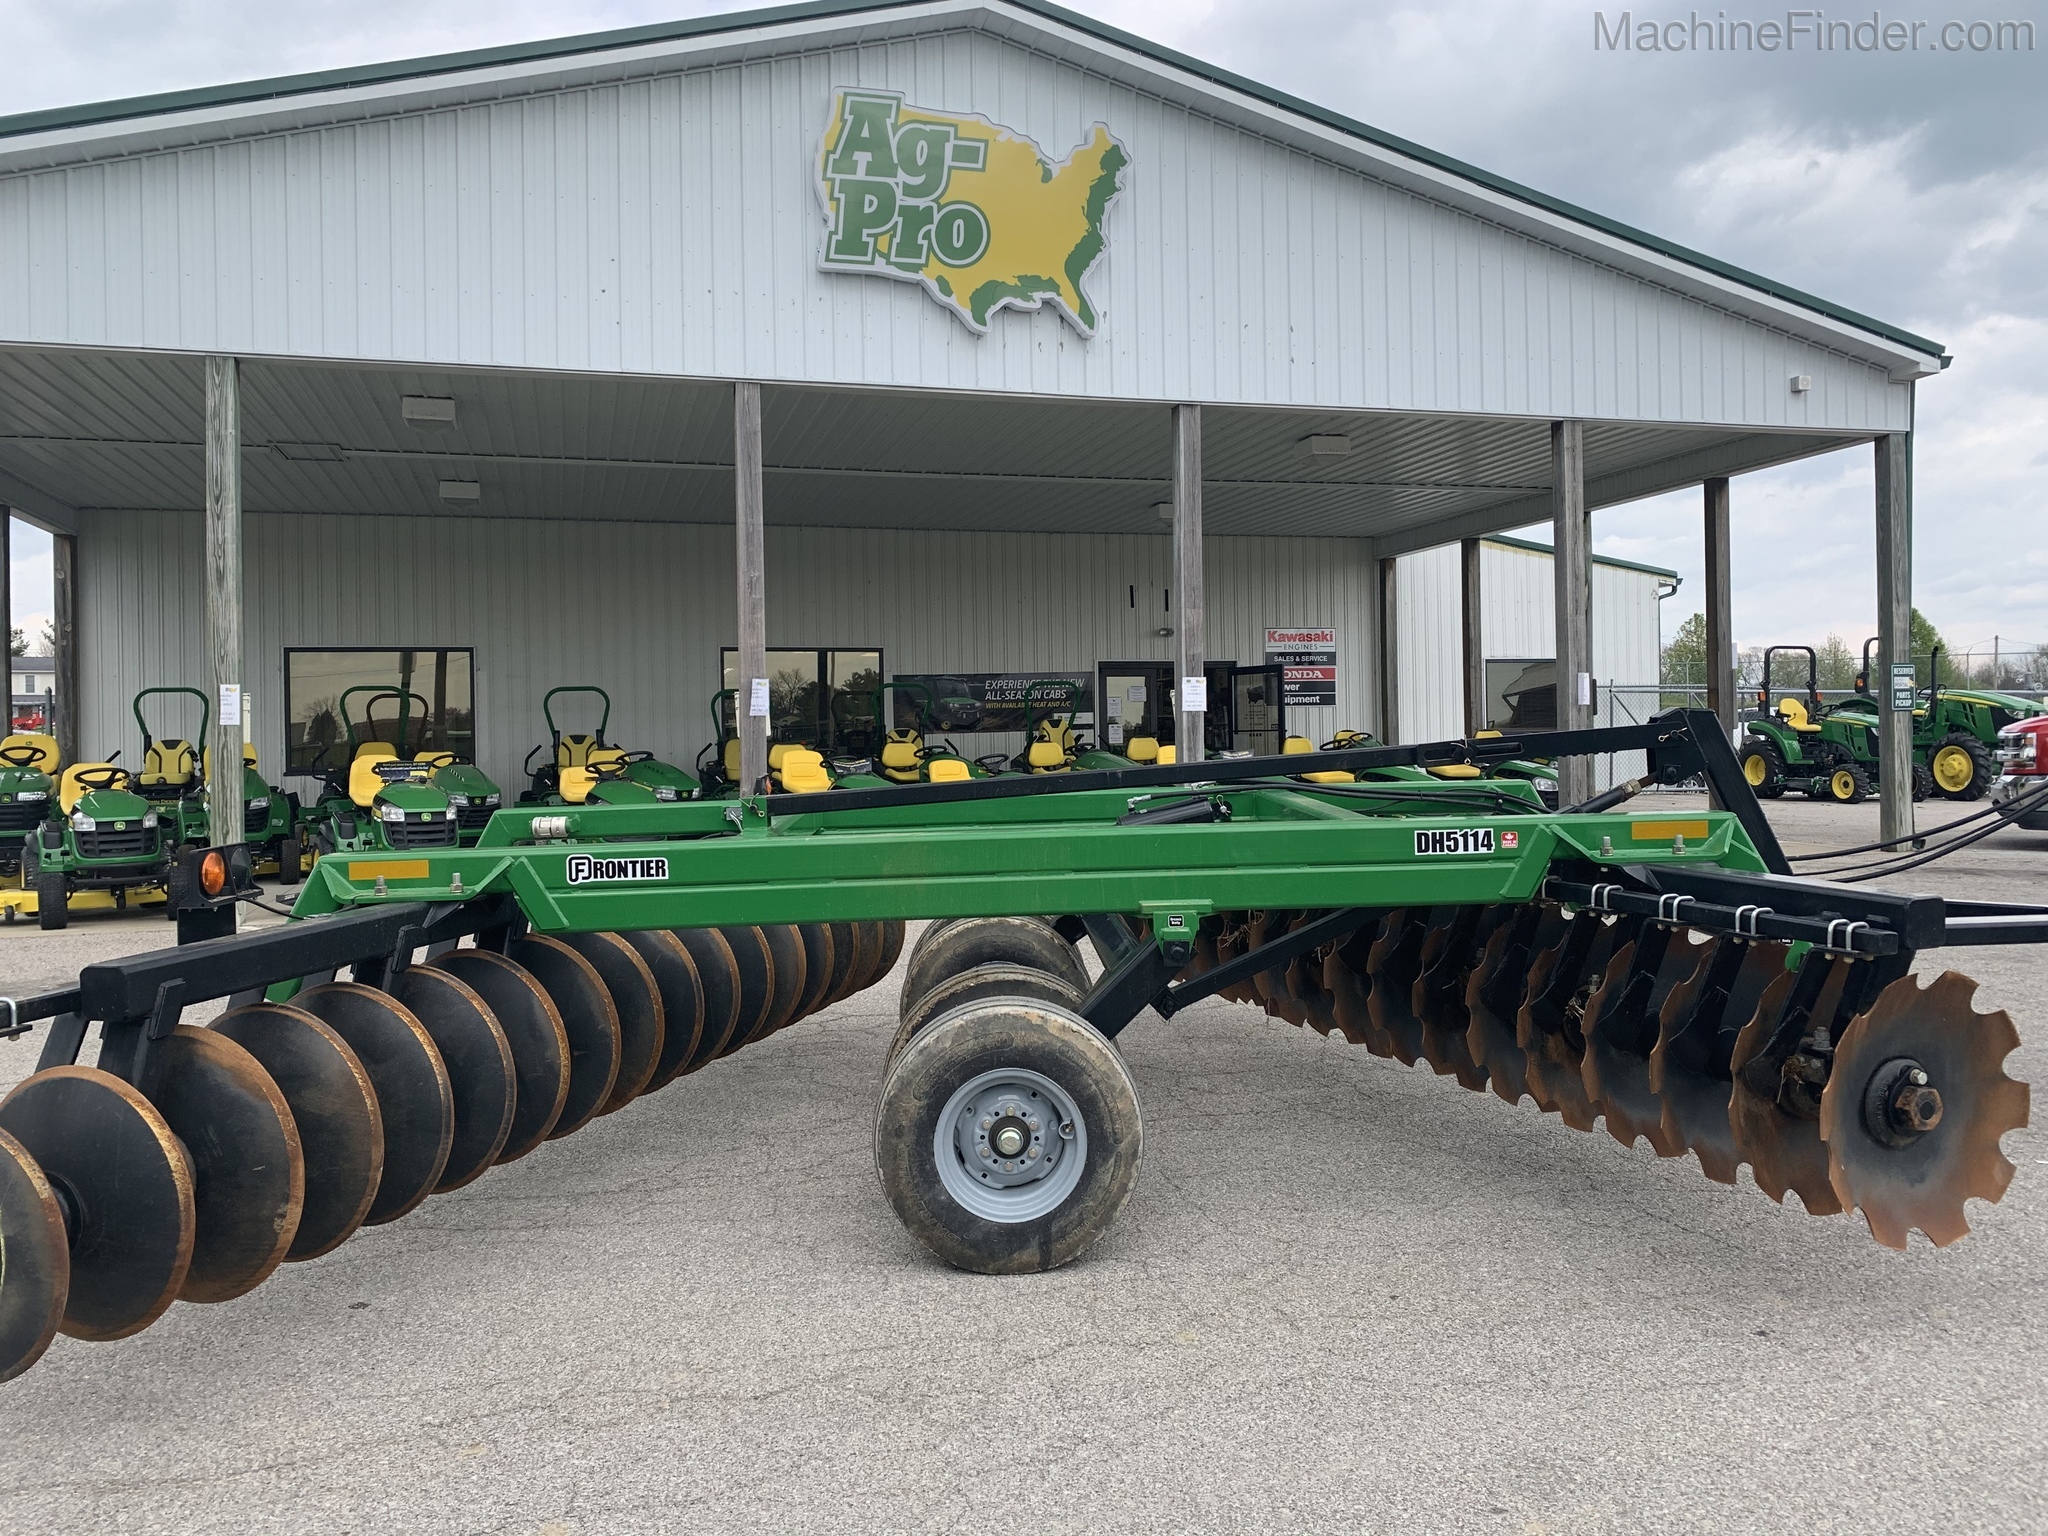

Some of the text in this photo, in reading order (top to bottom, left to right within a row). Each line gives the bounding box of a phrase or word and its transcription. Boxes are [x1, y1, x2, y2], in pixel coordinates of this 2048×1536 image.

[824, 93, 988, 201] Ag-
[825, 178, 990, 268] Pro
[1267, 631, 1334, 642] Kawasaki
[985, 690, 1067, 700] ALL-SEASON CABS
[1284, 695, 1320, 705] ipment
[1001, 701, 1032, 709] AVAILABE
[1416, 830, 1494, 853] DH5114
[568, 856, 667, 883] FRONTIER
